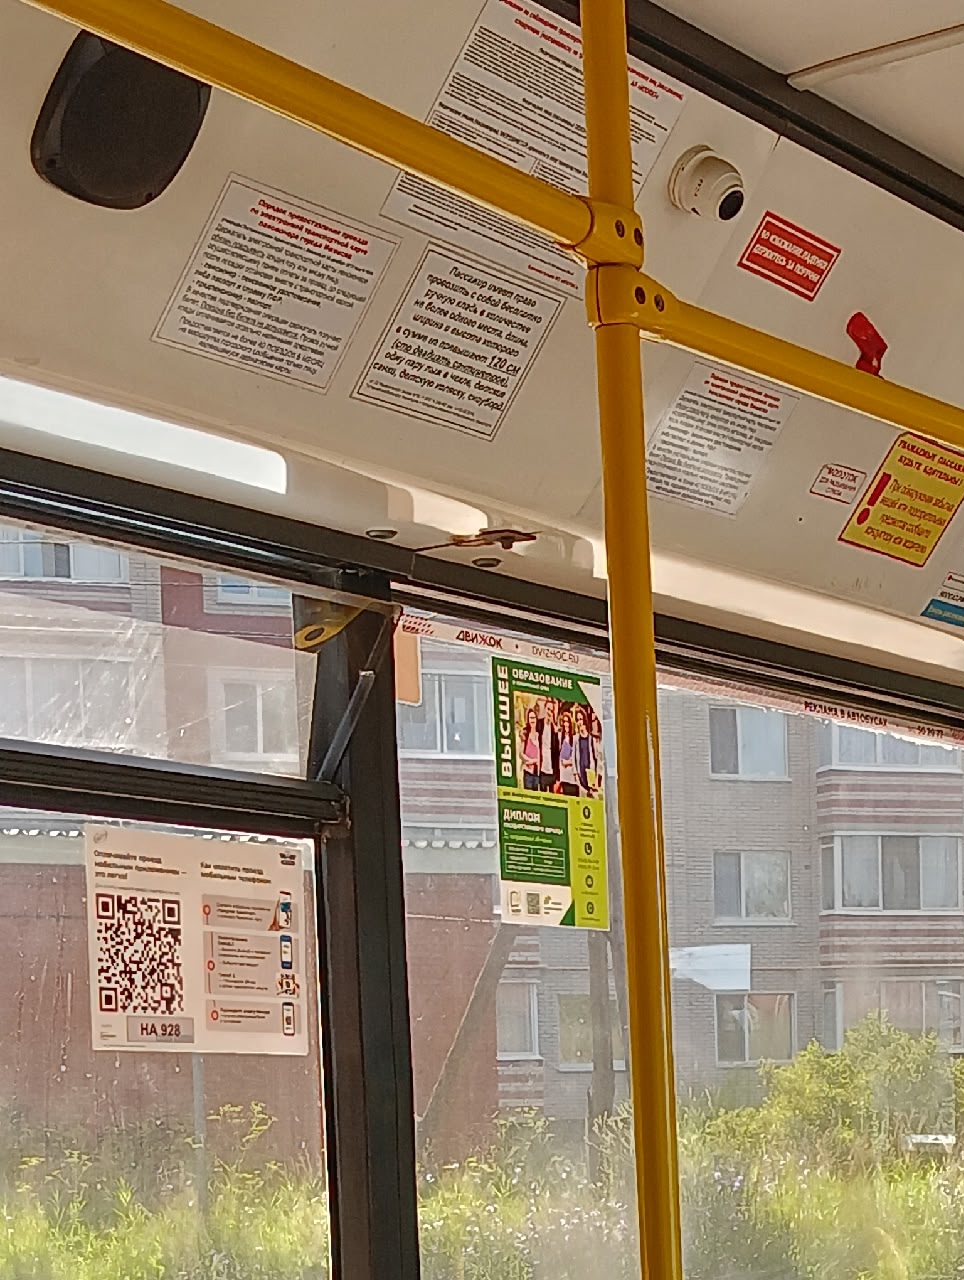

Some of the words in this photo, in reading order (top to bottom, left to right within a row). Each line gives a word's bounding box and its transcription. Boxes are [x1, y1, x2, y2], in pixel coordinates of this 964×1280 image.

[449, 266, 487, 289] Пассажир
[455, 300, 478, 314] кладь
[476, 293, 501, 307] собой
[412, 314, 444, 329] ширина
[448, 311, 477, 328] одного
[488, 355, 507, 369] 120
[506, 363, 521, 374] см
[456, 630, 503, 649] ДВИЖОК
[512, 668, 573, 690] ОБРАЗОВАНИЕ
[497, 664, 512, 778] ВЫСШЕЕ
[804, 701, 839, 718] РЕКЛАМА
[847, 712, 888, 727] АВТОБУСАХ
[503, 808, 541, 823] ДИПЛОМ
[161, 1023, 181, 1037] 928
